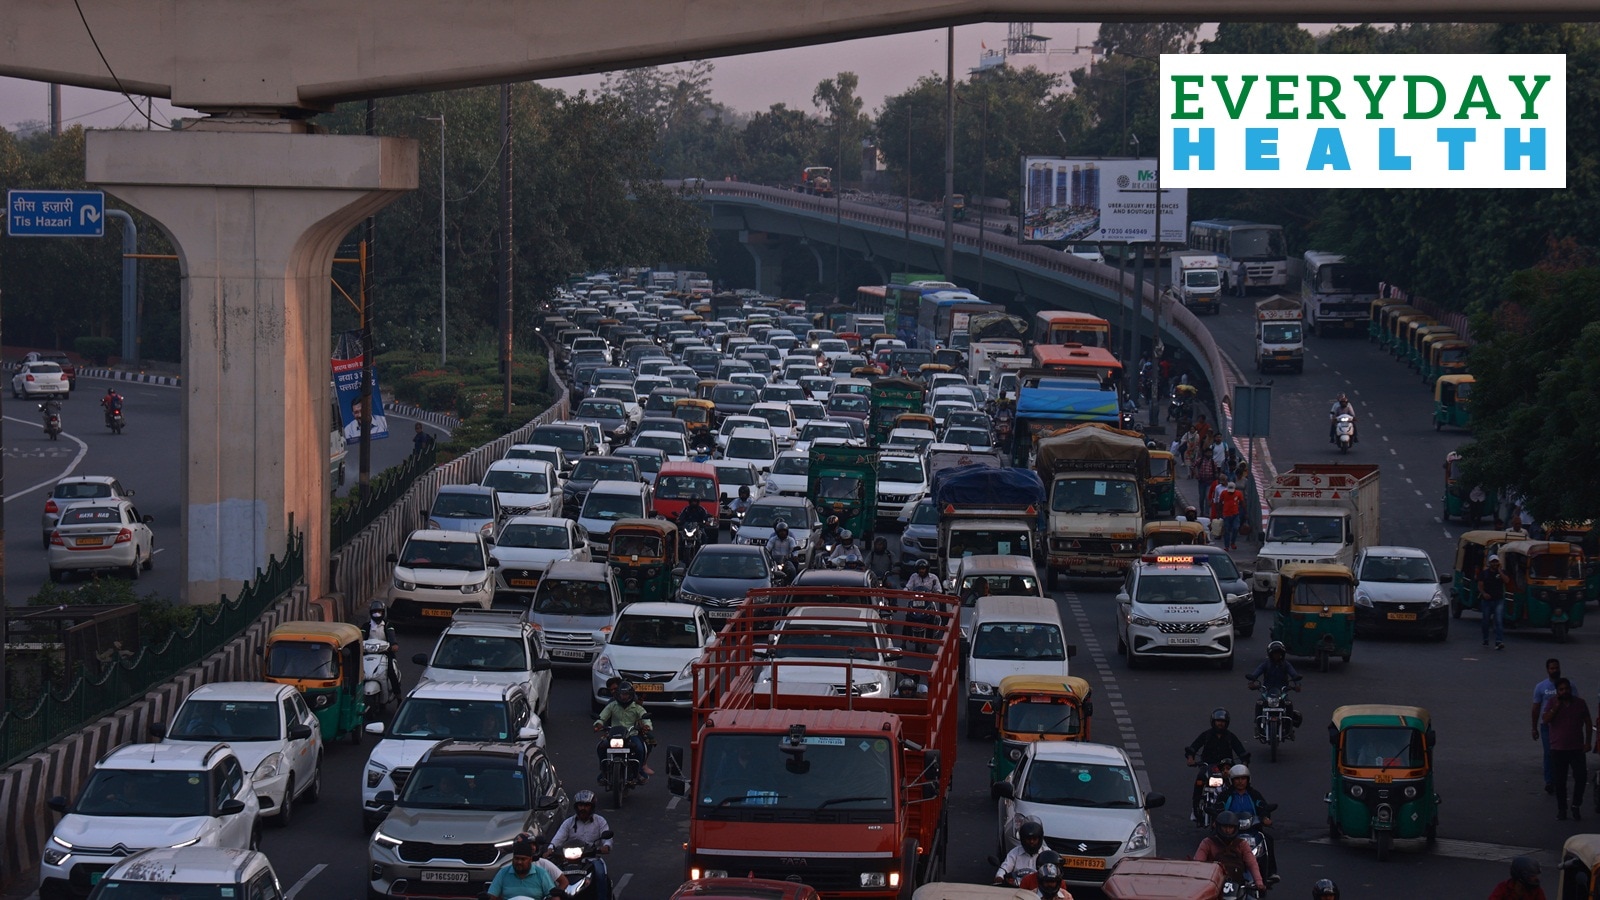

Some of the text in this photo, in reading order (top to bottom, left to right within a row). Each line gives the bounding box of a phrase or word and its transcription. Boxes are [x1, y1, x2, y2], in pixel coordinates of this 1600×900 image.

[13, 197, 73, 214] तीस हज़ारी
[14, 216, 72, 227] Tis Hazari
[780, 857, 809, 866] TATA
